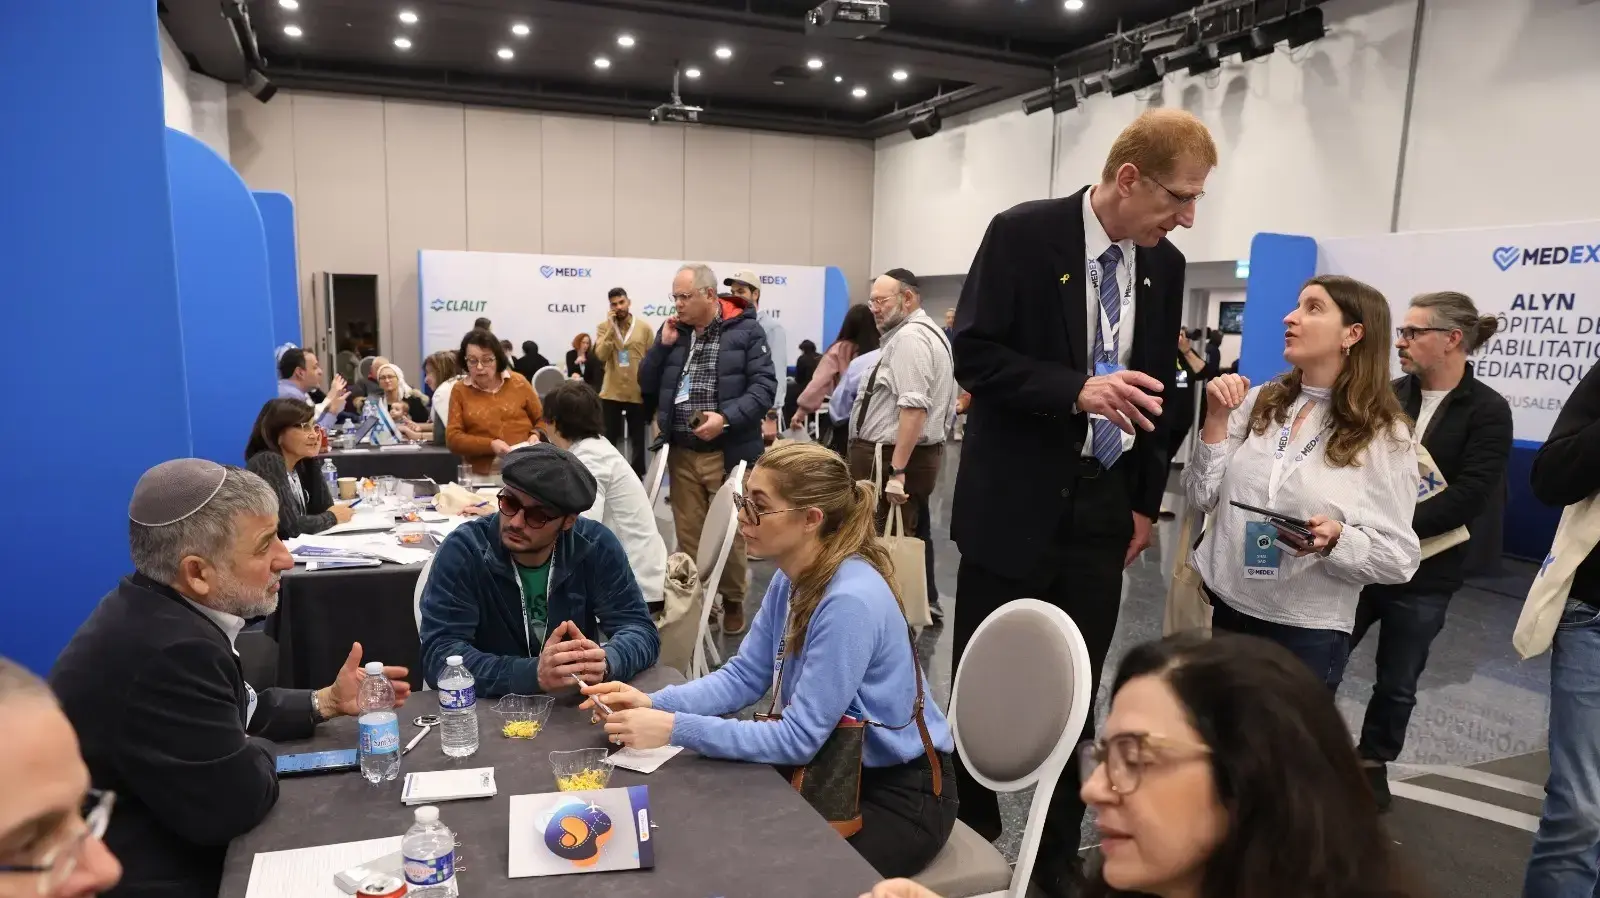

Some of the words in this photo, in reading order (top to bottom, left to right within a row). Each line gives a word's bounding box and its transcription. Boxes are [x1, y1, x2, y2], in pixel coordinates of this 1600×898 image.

[1522, 244, 1600, 266] MEDEX
[555, 268, 592, 277] MEDEX
[1088, 258, 1099, 289] MEDEX
[446, 300, 487, 312] CLALIT
[547, 304, 586, 313] CLALIT
[1510, 293, 1576, 311] ALYN
[1496, 312, 1569, 334] ÔPITAL
[1278, 426, 1290, 452] MEDEX
